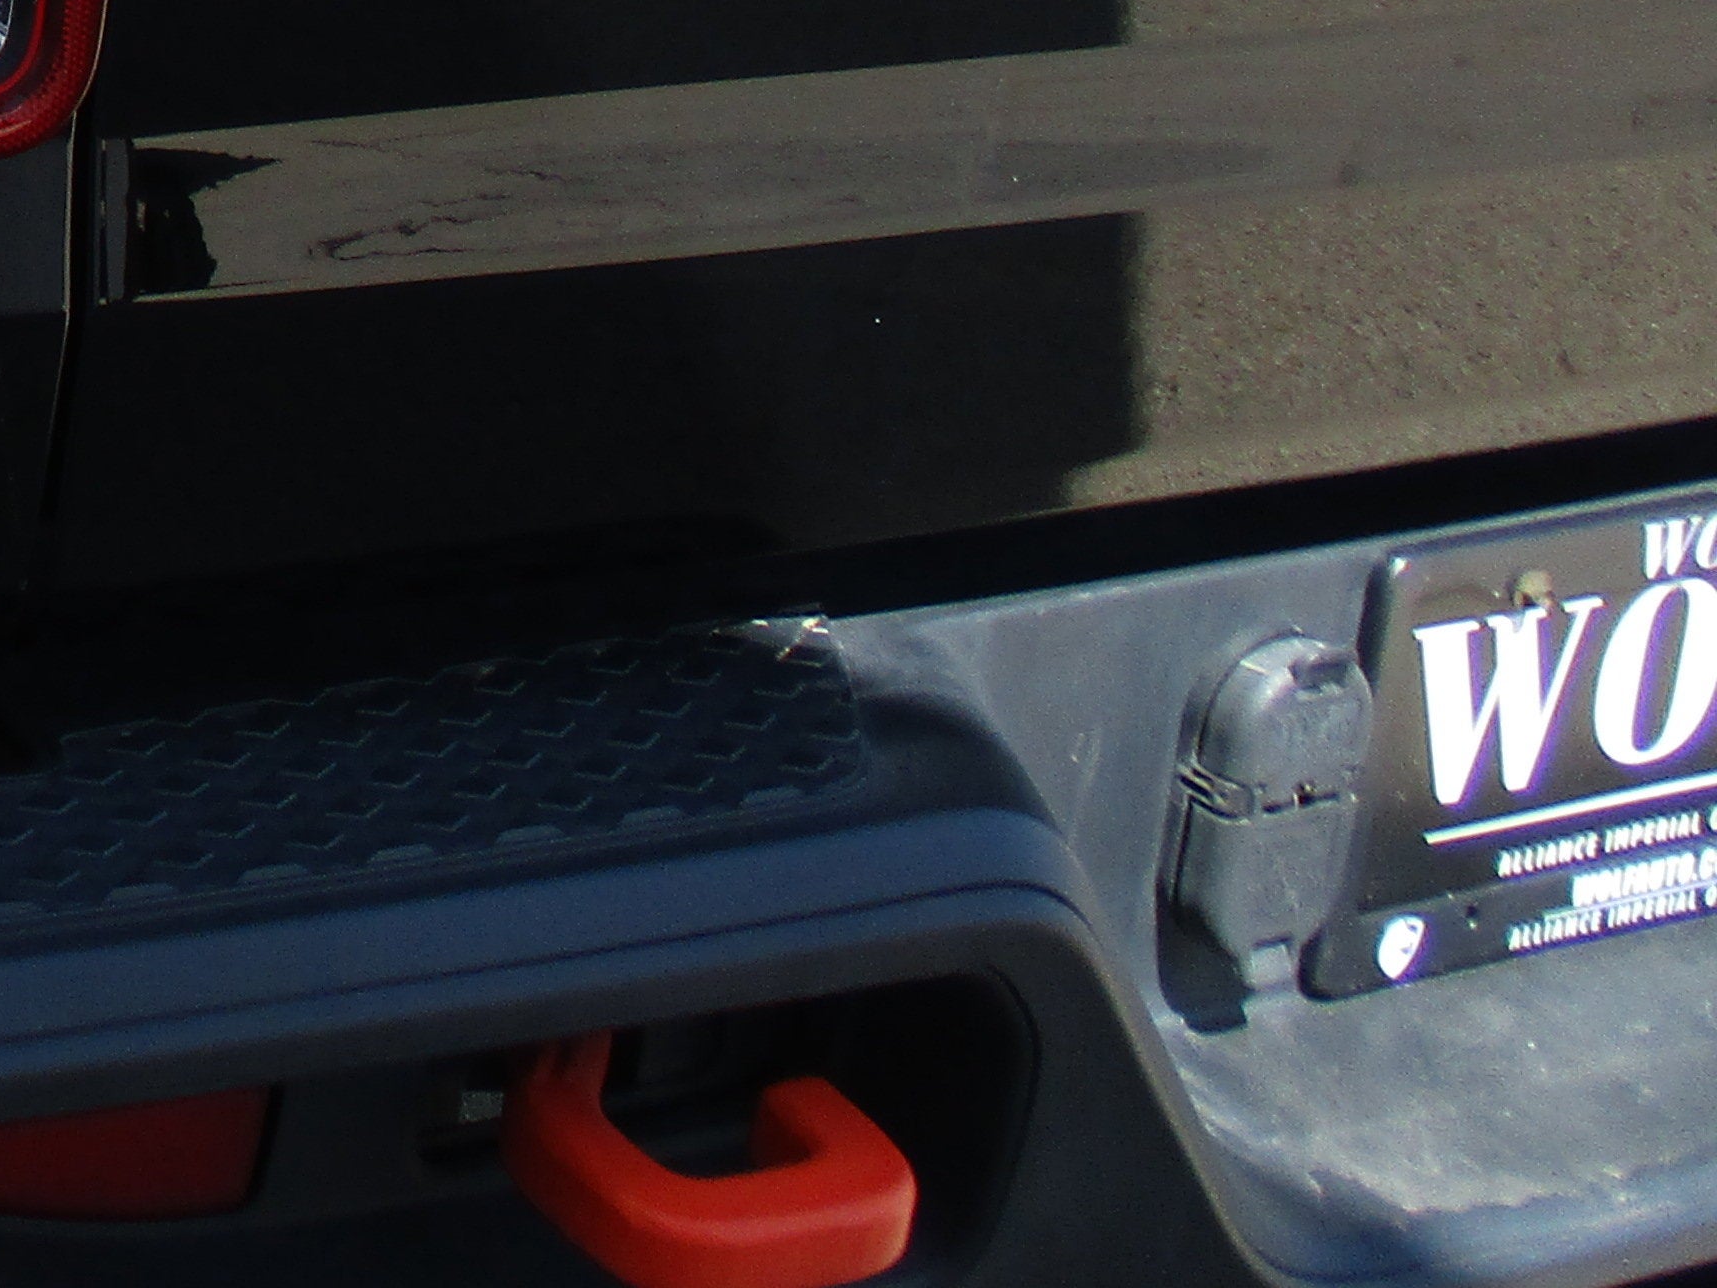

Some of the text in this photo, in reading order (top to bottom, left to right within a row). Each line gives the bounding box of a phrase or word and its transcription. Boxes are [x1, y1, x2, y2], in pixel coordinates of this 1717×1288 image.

[1497, 831, 1600, 878] ALLIANCE
[1604, 811, 1701, 854] IMPERIAL
[1573, 847, 1717, 908] WOLFAUTO.C
[1508, 911, 1602, 951] ALLIANCE
[1607, 889, 1697, 928] IMPERIAL
